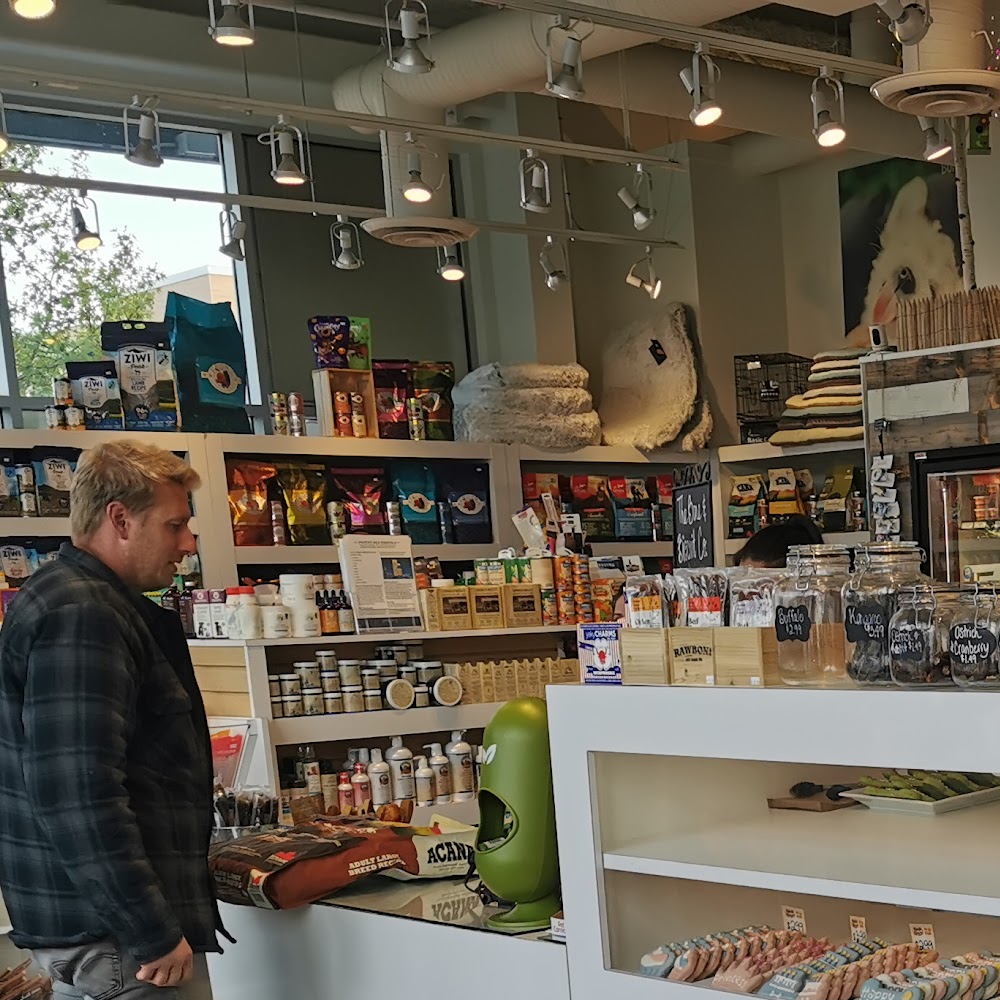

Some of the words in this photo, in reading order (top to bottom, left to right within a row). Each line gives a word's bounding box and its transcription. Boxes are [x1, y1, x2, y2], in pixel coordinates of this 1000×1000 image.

[124, 354, 151, 363] ZIWI
[3, 550, 21, 558] ZIWI
[954, 625, 983, 640] Ostrich
[349, 858, 375, 869] ADULT
[348, 863, 377, 876] BREED
